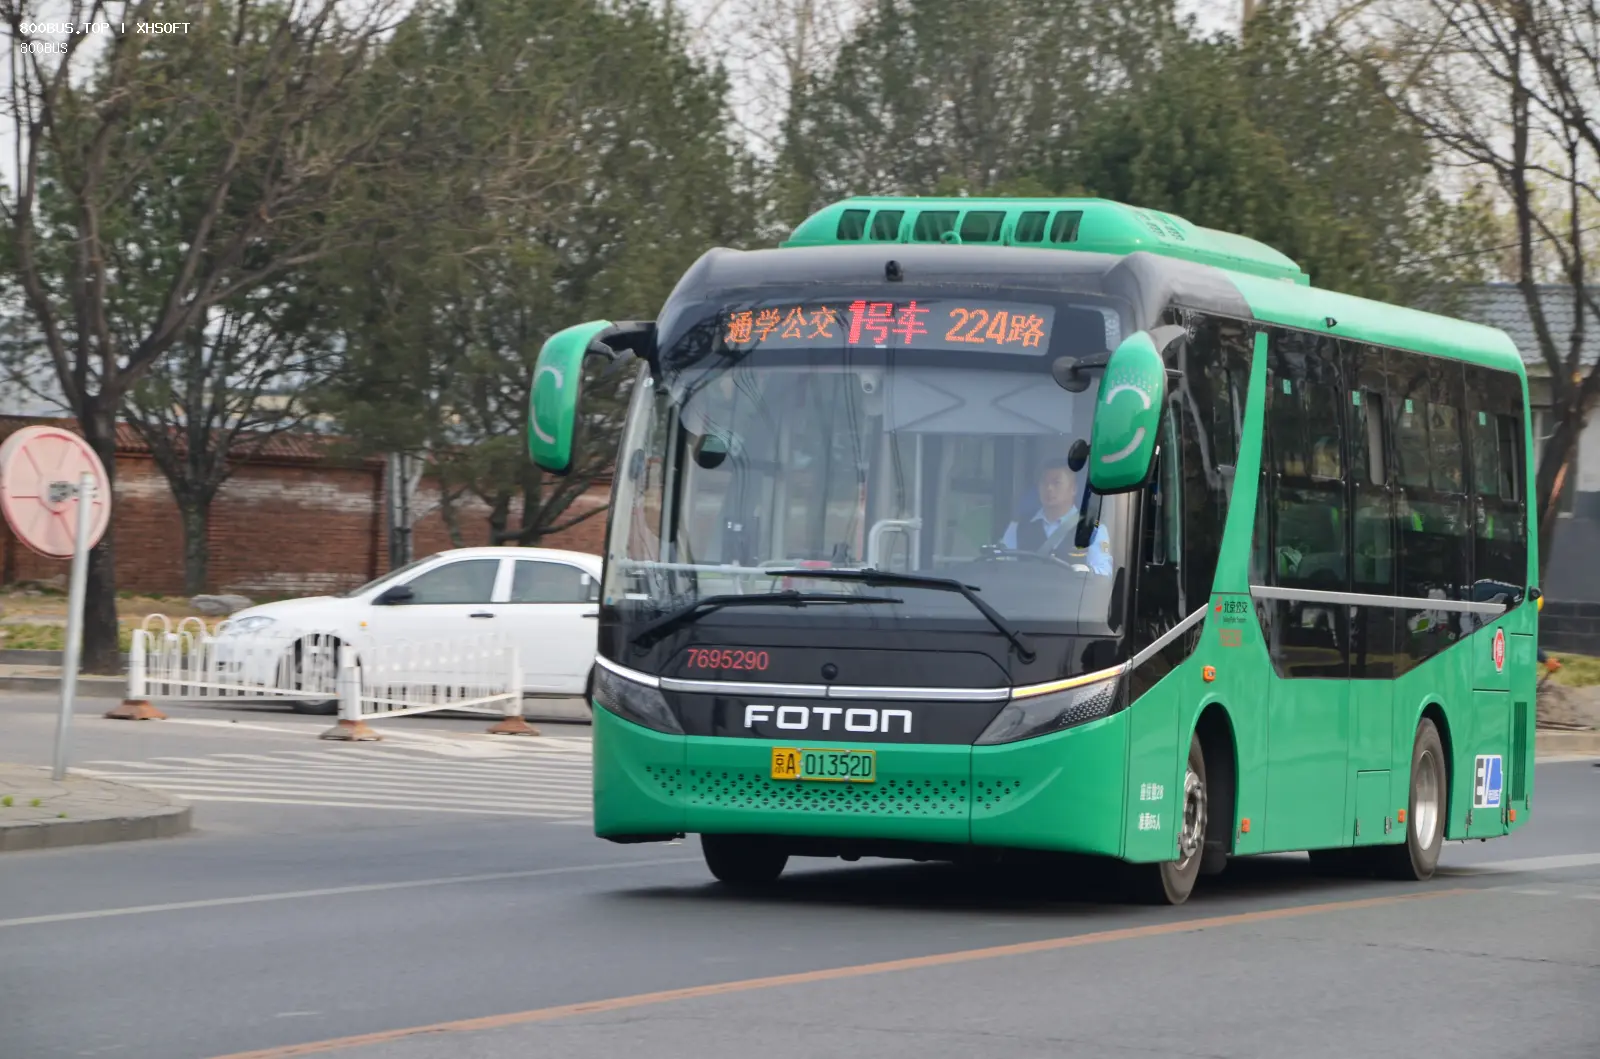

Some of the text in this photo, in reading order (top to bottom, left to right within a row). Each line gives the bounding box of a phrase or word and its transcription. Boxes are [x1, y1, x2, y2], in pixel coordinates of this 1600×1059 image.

[724, 300, 1045, 347] 通学公交 1号车 224路
[686, 648, 770, 671] 7695290
[744, 704, 913, 734] FOTON
